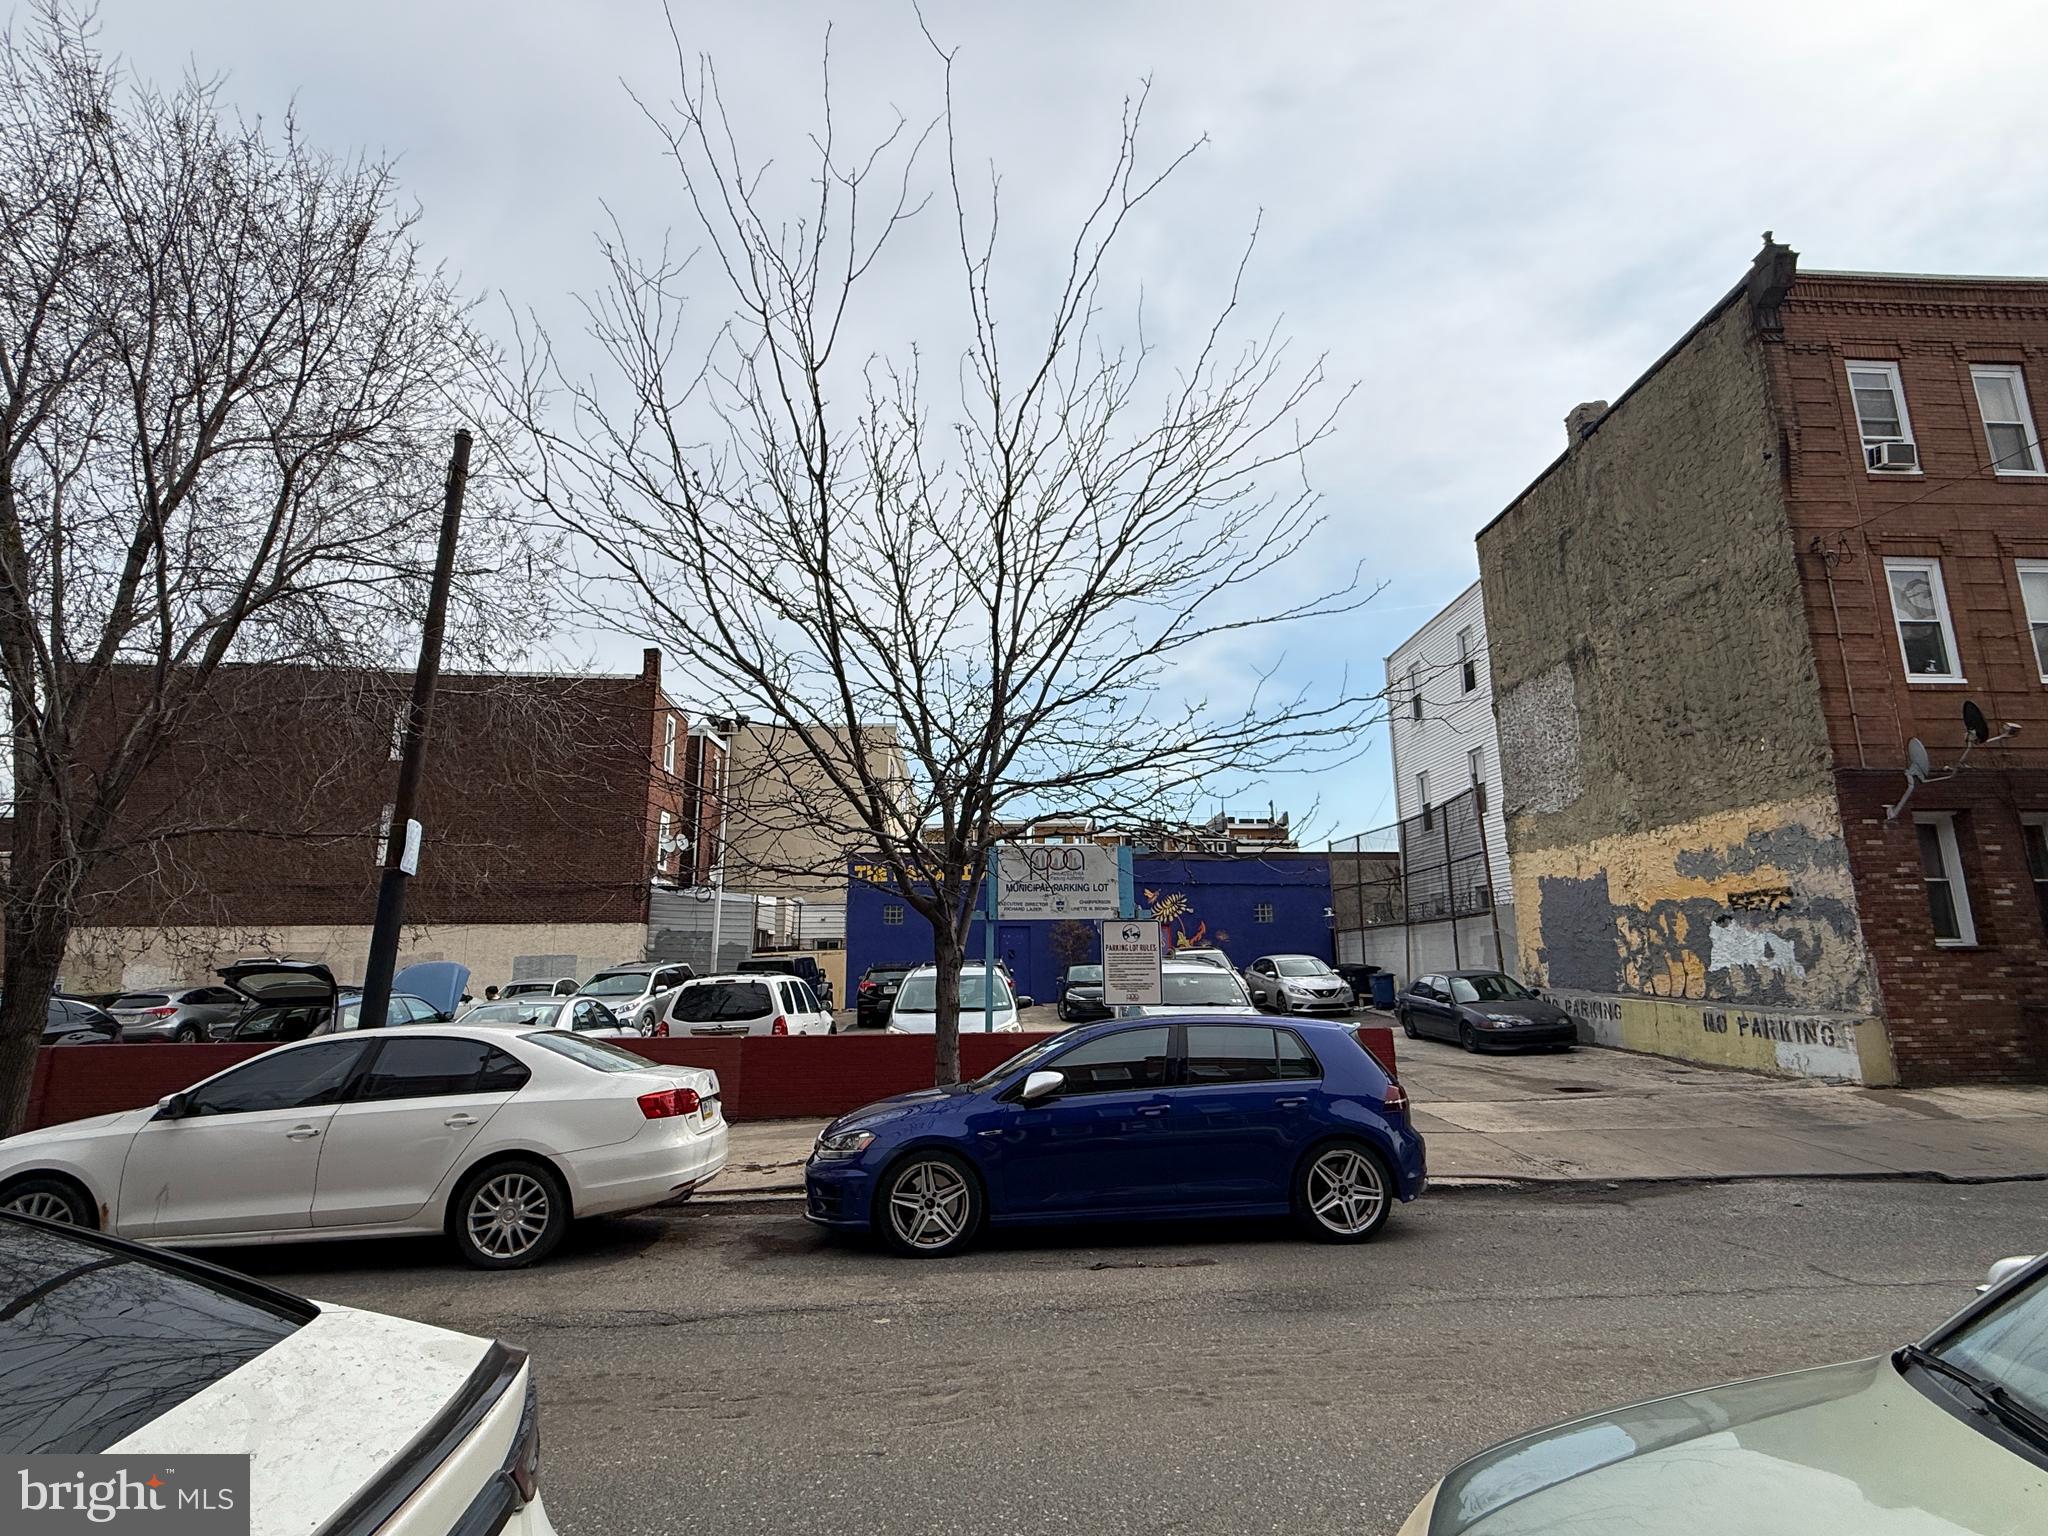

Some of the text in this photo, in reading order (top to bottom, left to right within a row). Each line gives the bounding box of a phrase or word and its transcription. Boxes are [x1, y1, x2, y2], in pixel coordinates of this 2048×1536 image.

[1005, 883, 1109, 892] MUNICIPAL PARKING LOT
[1105, 943, 1158, 952] PARKING LOT RULES:
[1564, 999, 1622, 1020] PARKING
[1702, 1011, 1835, 1047] NO PARKING
